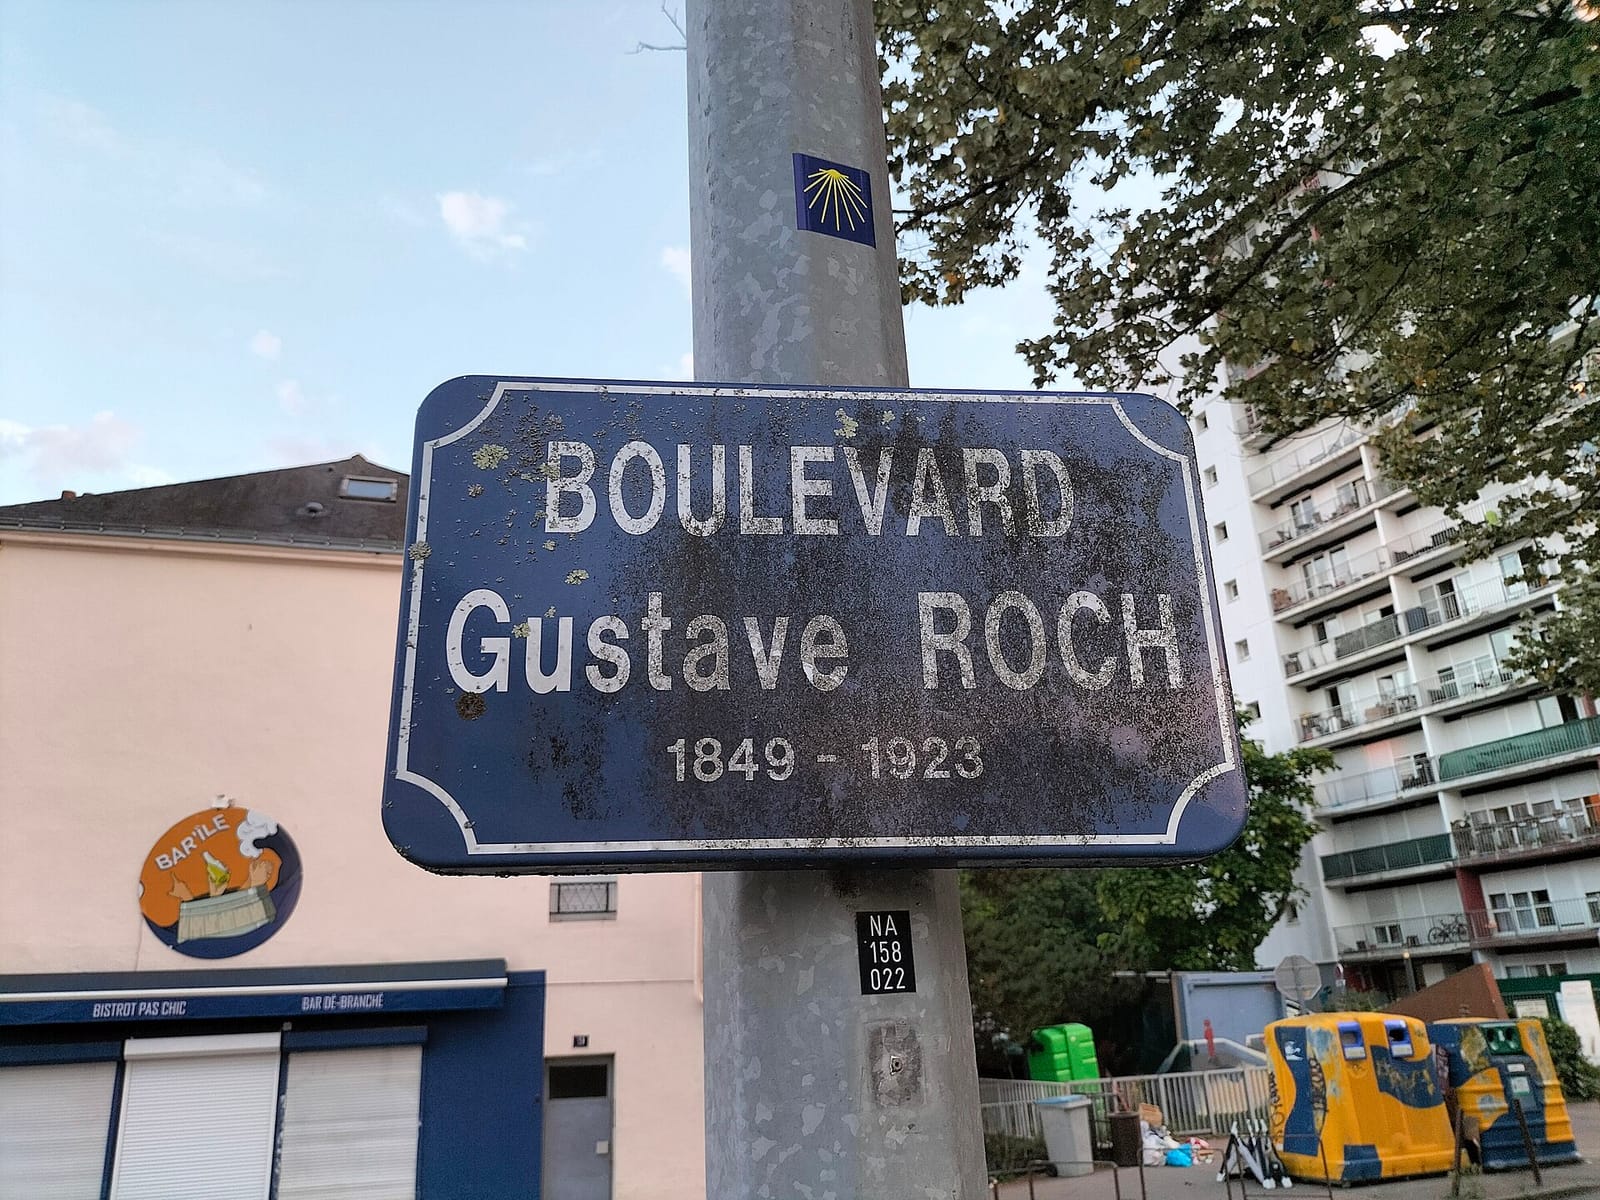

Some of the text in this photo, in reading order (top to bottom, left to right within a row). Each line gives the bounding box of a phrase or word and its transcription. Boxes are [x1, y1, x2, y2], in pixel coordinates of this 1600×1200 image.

[544, 440, 1075, 537] BOULEVARD
[446, 588, 1184, 694] Gustave ROCH
[667, 737, 795, 783] 1849
[860, 735, 985, 780] 1923
[870, 914, 898, 937] NA
[870, 940, 902, 963] 158
[870, 967, 906, 991] 022
[93, 1000, 187, 1018] BISTROT PAS CHIC
[302, 996, 322, 1010] BAR
